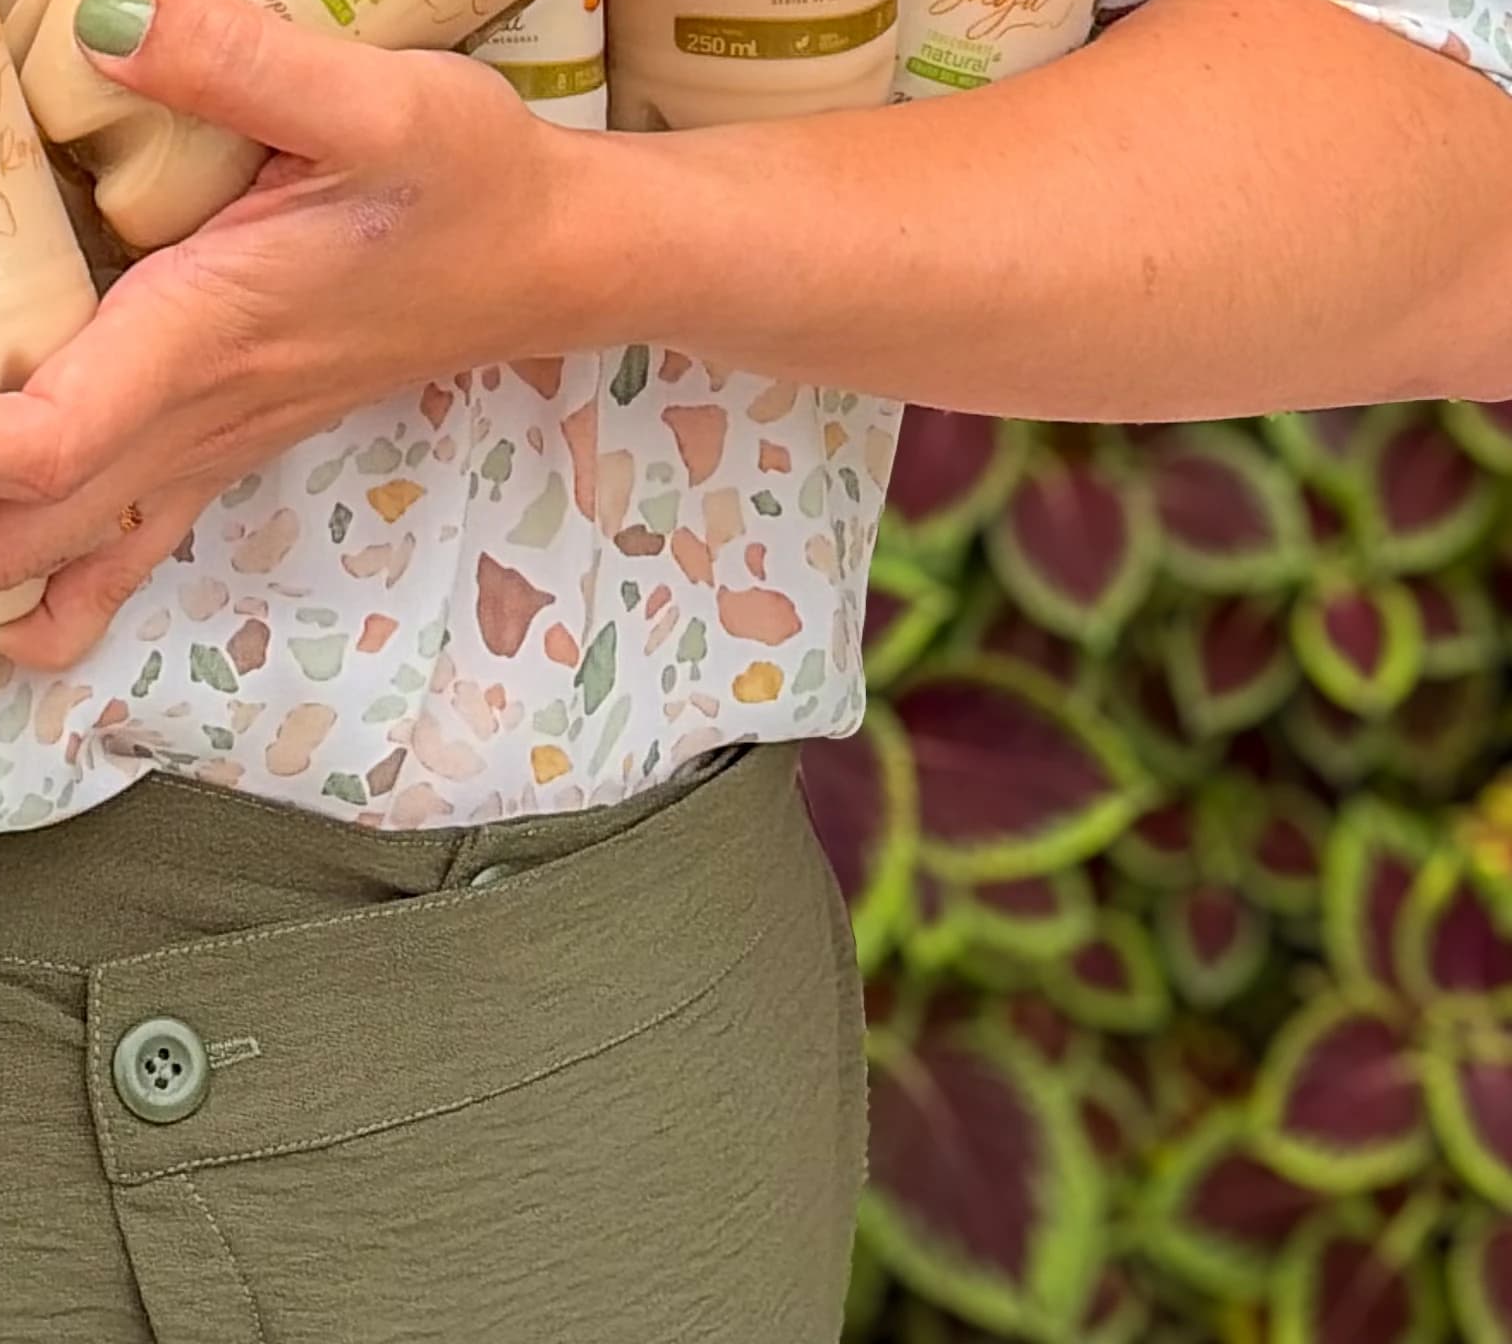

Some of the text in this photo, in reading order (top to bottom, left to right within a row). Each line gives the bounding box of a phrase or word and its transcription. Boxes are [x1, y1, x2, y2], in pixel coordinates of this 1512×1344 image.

[687, 33, 758, 58] 250 ml
[921, 43, 990, 73] natural
